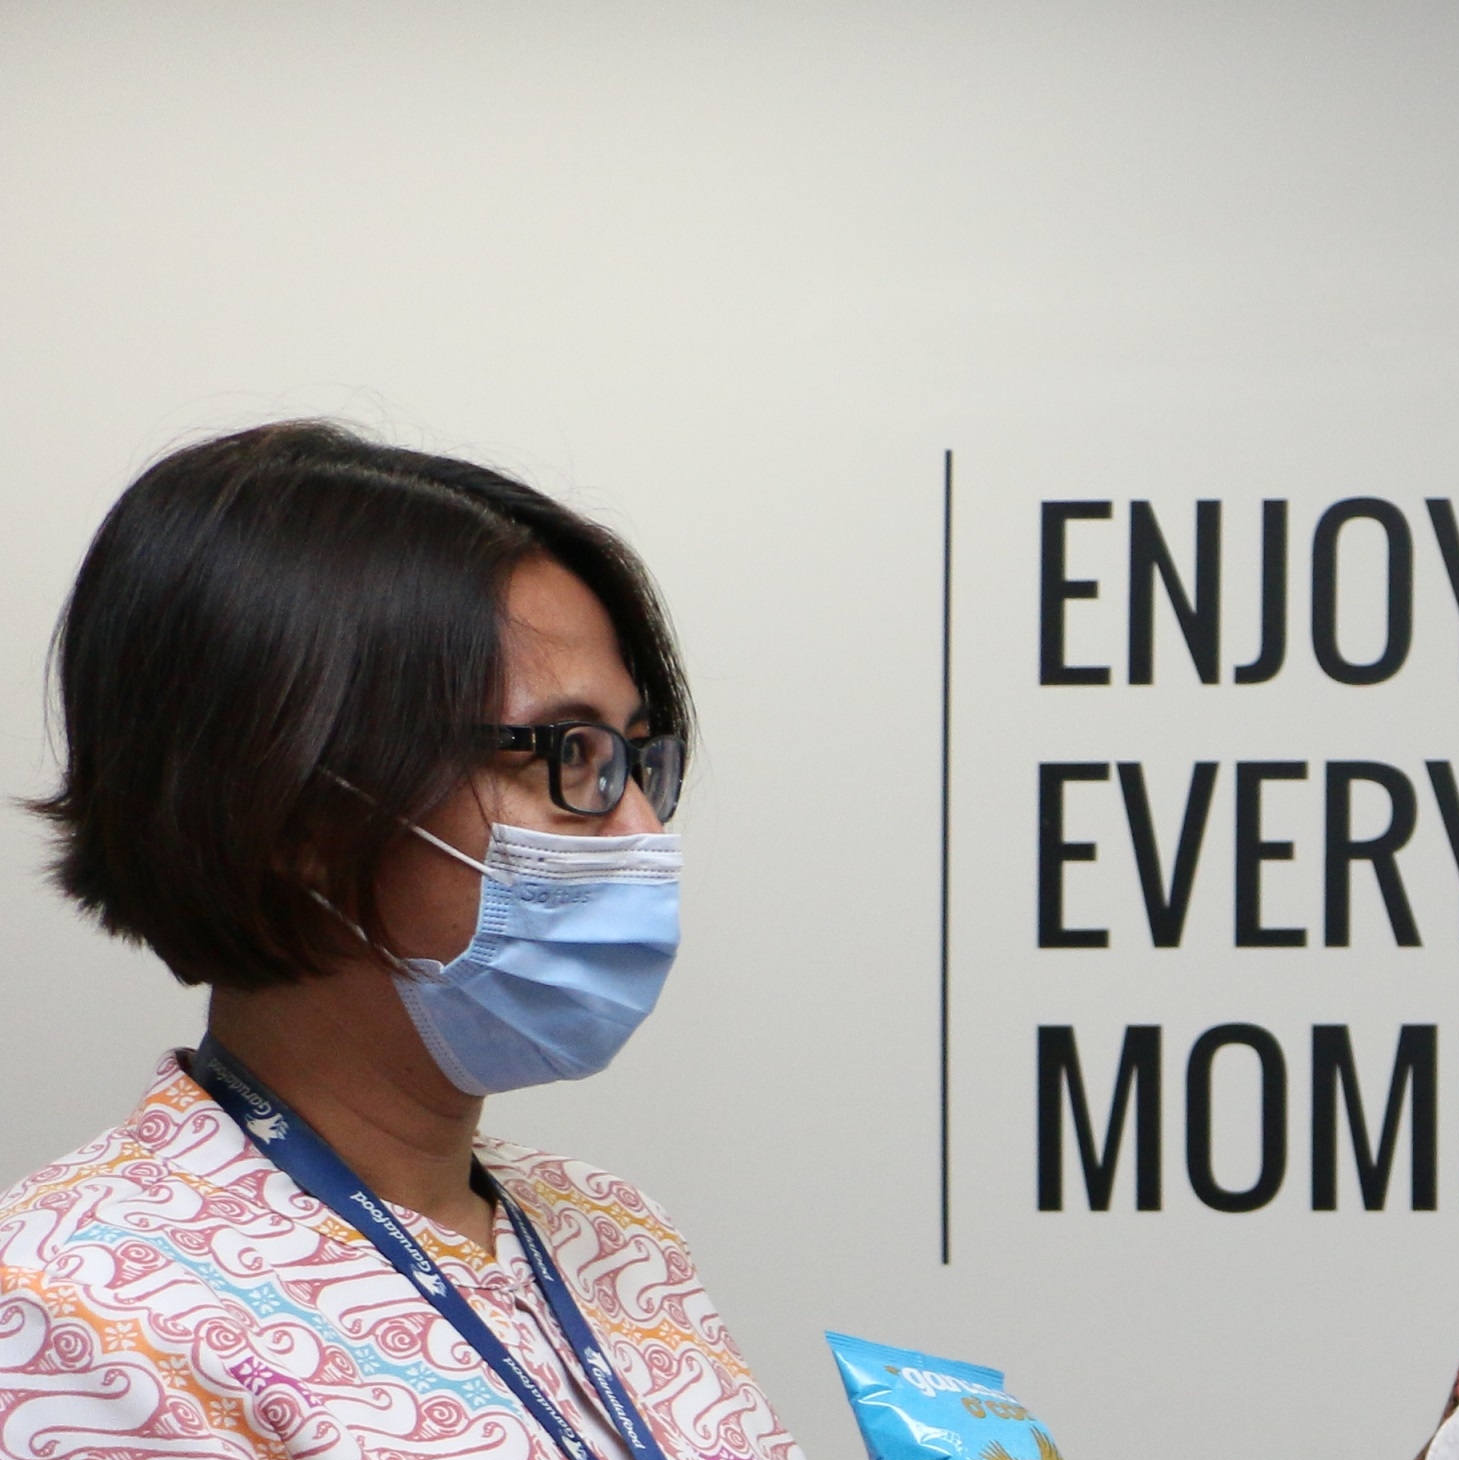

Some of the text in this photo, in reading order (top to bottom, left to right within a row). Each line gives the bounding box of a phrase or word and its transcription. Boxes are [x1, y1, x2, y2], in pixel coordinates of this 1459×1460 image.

[349, 1190, 433, 1273] Garudafood
[502, 1357, 576, 1440] Garudafood
[592, 1366, 647, 1451] Garudafood
